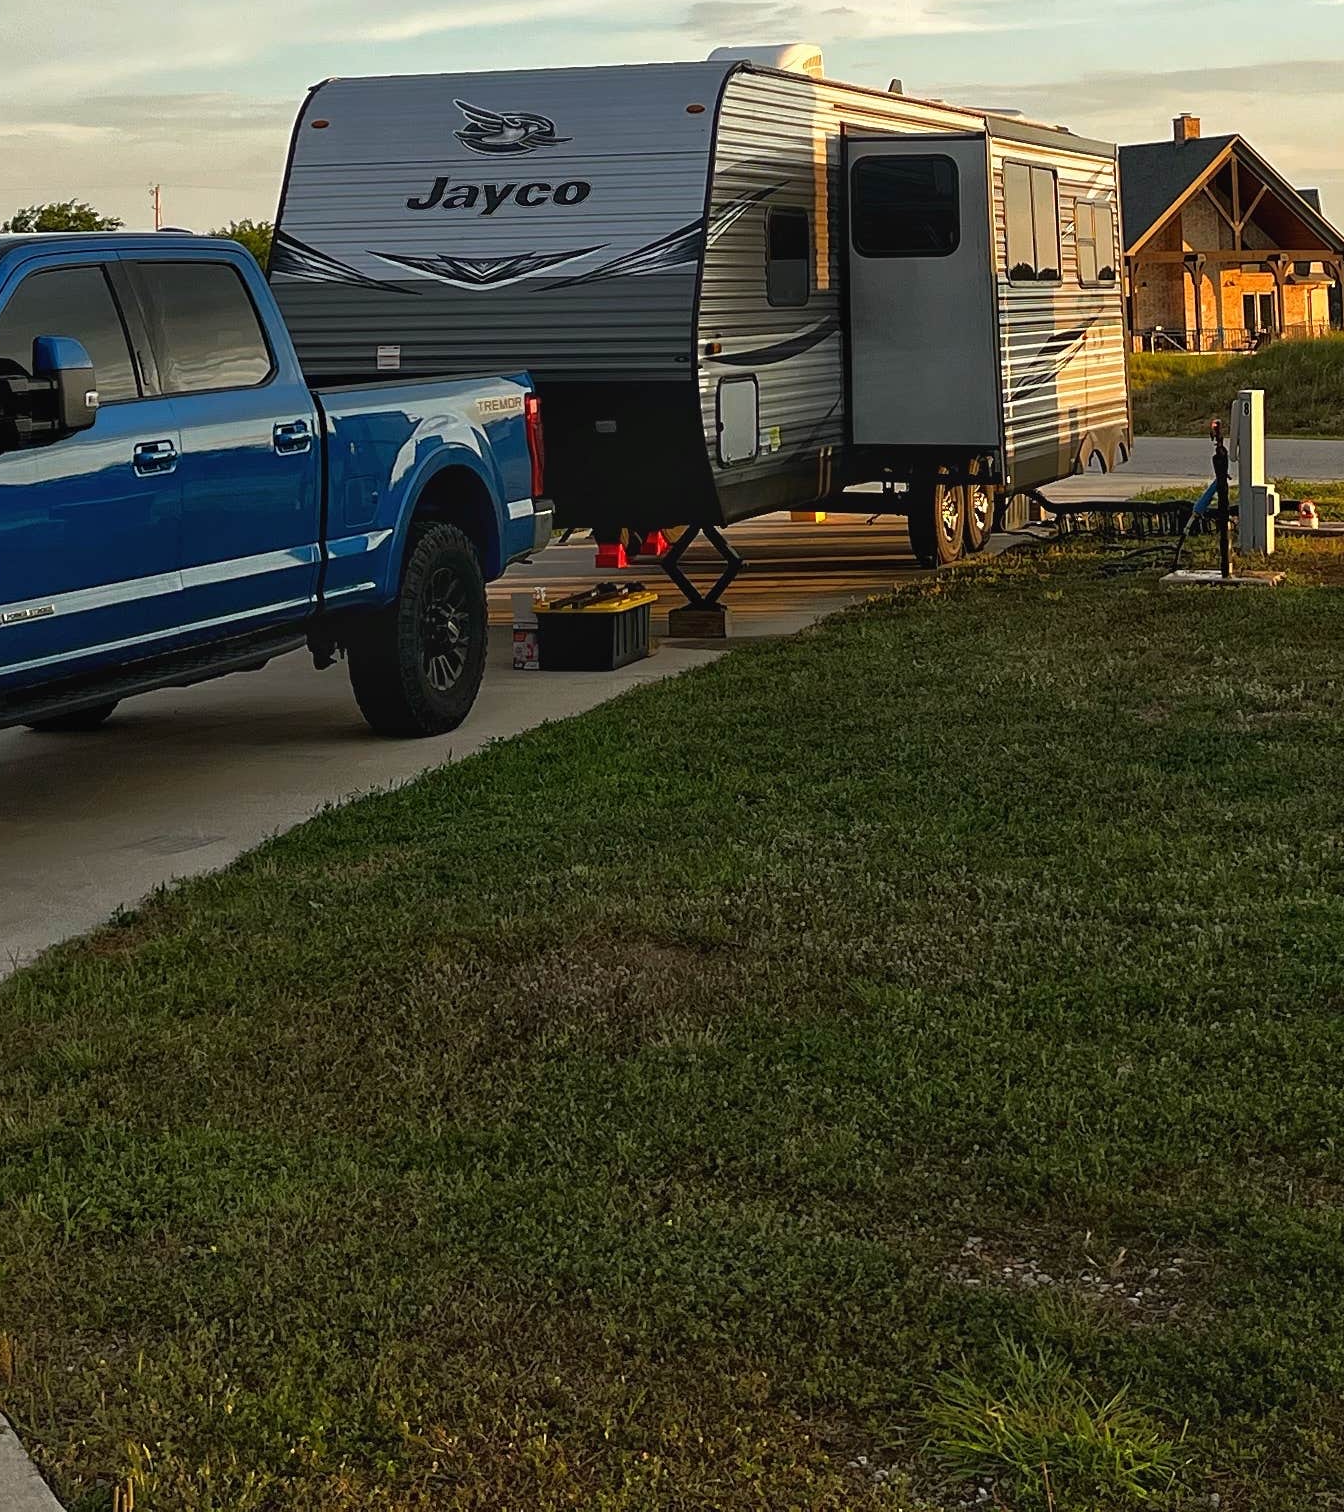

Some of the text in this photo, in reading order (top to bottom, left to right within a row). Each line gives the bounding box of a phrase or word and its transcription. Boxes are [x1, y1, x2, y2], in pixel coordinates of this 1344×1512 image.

[406, 175, 592, 216] Jayco
[477, 397, 522, 411] TREMOR
[1243, 402, 1250, 416] 8
